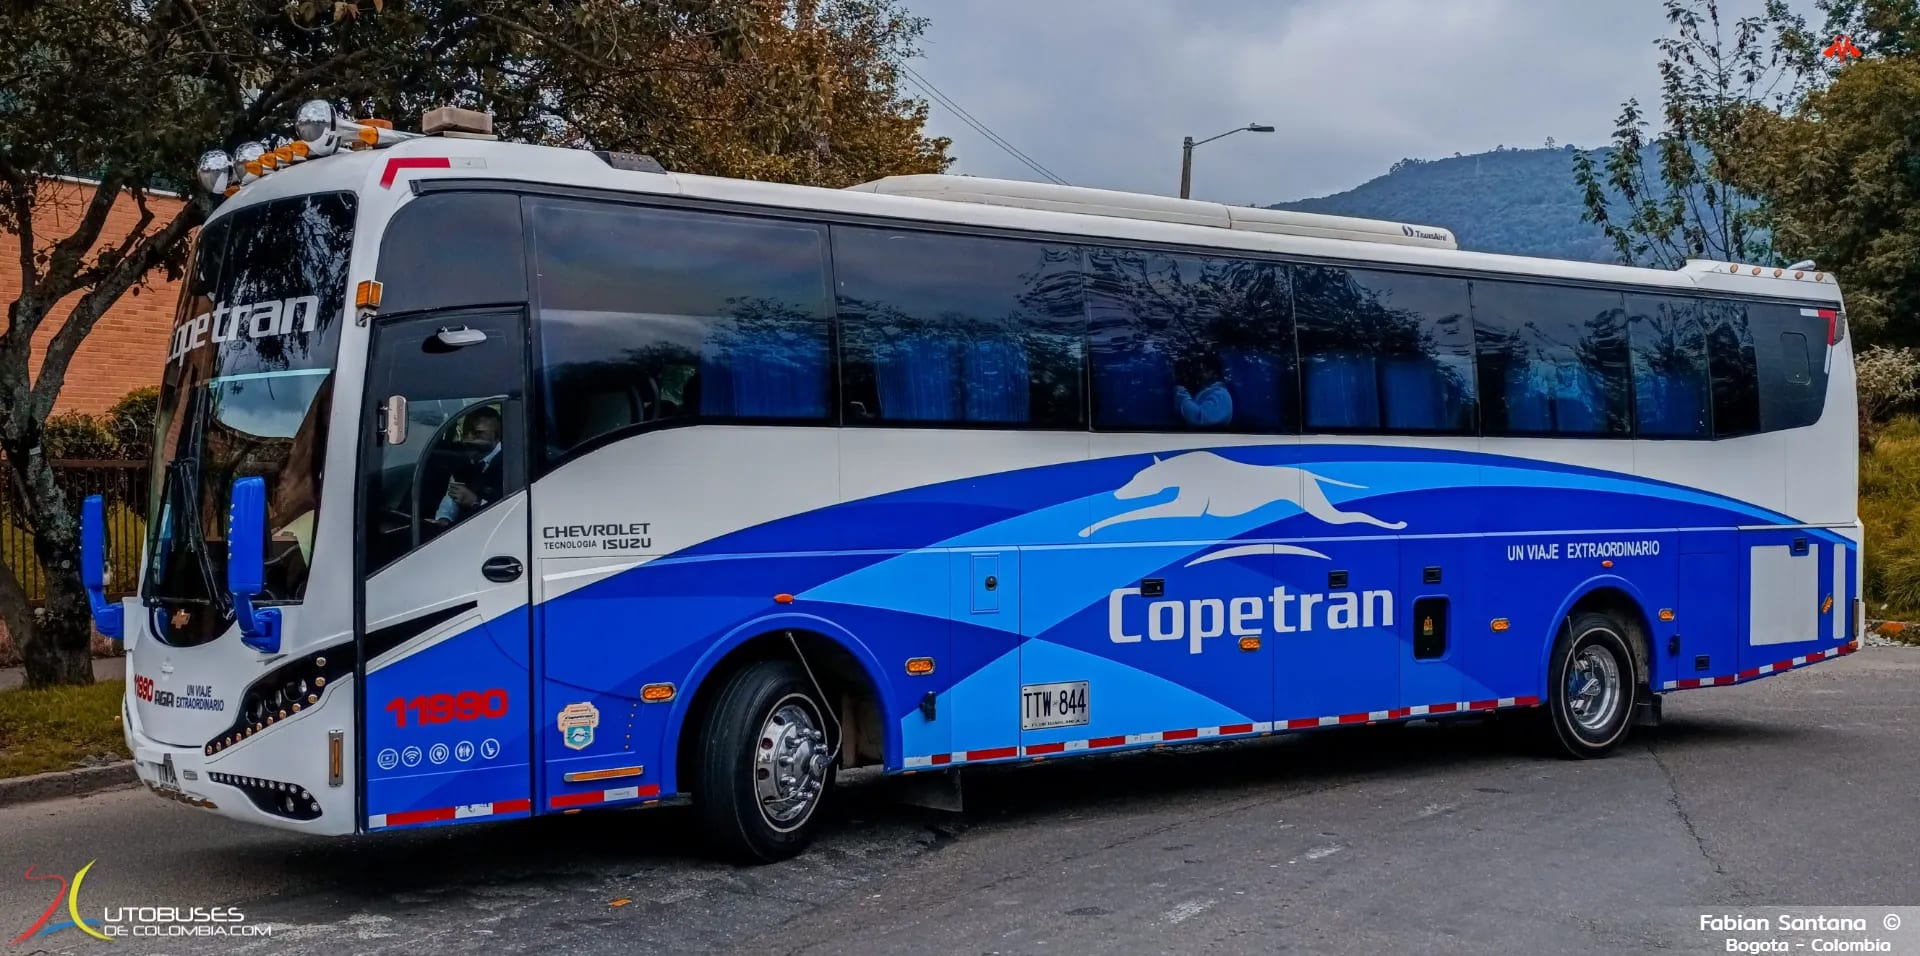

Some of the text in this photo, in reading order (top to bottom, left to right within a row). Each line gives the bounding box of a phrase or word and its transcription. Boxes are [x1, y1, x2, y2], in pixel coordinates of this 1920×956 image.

[543, 523, 651, 539] CHEVROLET
[544, 538, 651, 550] TECNOLOGIA ISUZU
[1507, 540, 1660, 561] UN VIAJE EXTRAORDINARIO
[1109, 585, 1394, 655] Copetran
[154, 690, 175, 708] AGA
[186, 684, 212, 698] UN VIAJE
[176, 696, 225, 712] EXTRAORDINARIO
[1023, 688, 1086, 719] TTW 844
